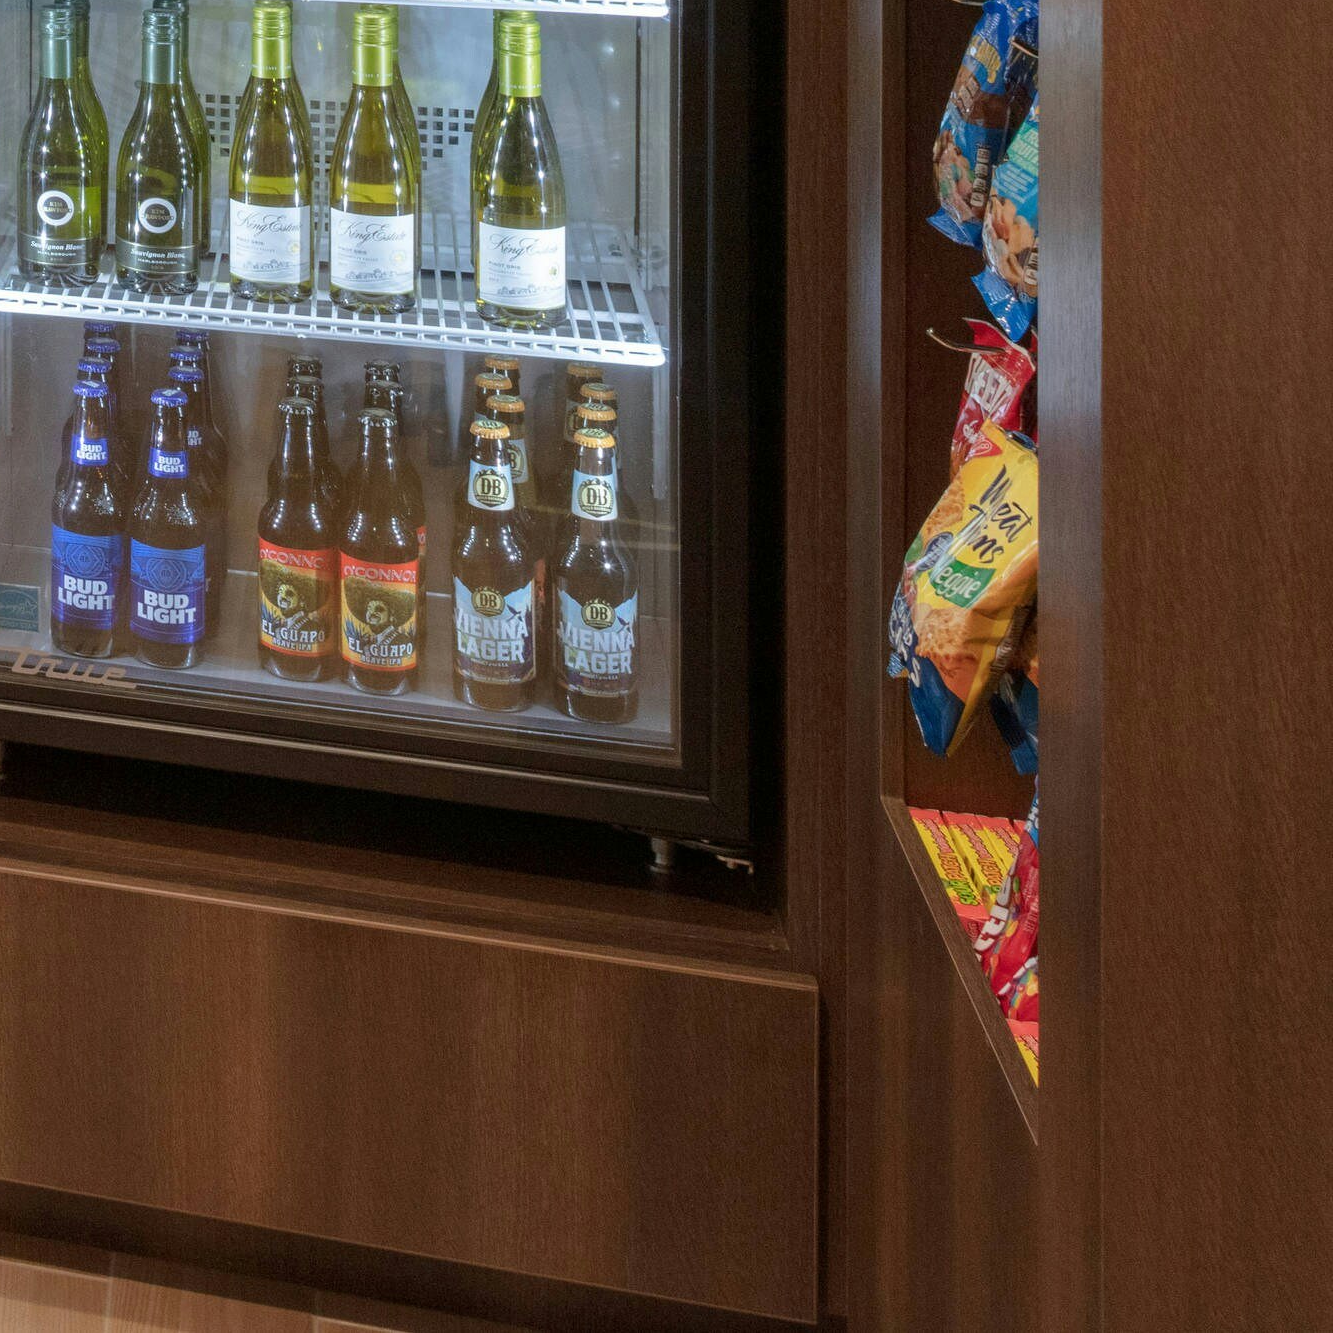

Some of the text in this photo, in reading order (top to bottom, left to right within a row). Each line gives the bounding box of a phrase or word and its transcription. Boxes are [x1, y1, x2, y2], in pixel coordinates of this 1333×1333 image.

[76, 449, 106, 462] LIGHT
[79, 443, 103, 454] BUD
[153, 462, 185, 474] LIGHT
[157, 455, 181, 466] BUD
[481, 478, 502, 496] DB
[586, 487, 607, 506] DB
[63, 574, 108, 596] BUD
[58, 590, 115, 612] LIGHT
[143, 589, 190, 609] BUD
[480, 594, 497, 608] DB
[137, 603, 197, 626] LIGHT
[590, 605, 608, 620] DB
[262, 620, 325, 645] EL GUAPO
[454, 607, 528, 639] VIENNA
[272, 637, 313, 651] AGAVE IPA
[557, 621, 635, 653] VIENNA
[348, 639, 414, 658] EL GUAPO
[457, 631, 525, 664] LAGER
[360, 654, 403, 667] AGAVE IPA
[564, 645, 632, 675] LAGER
